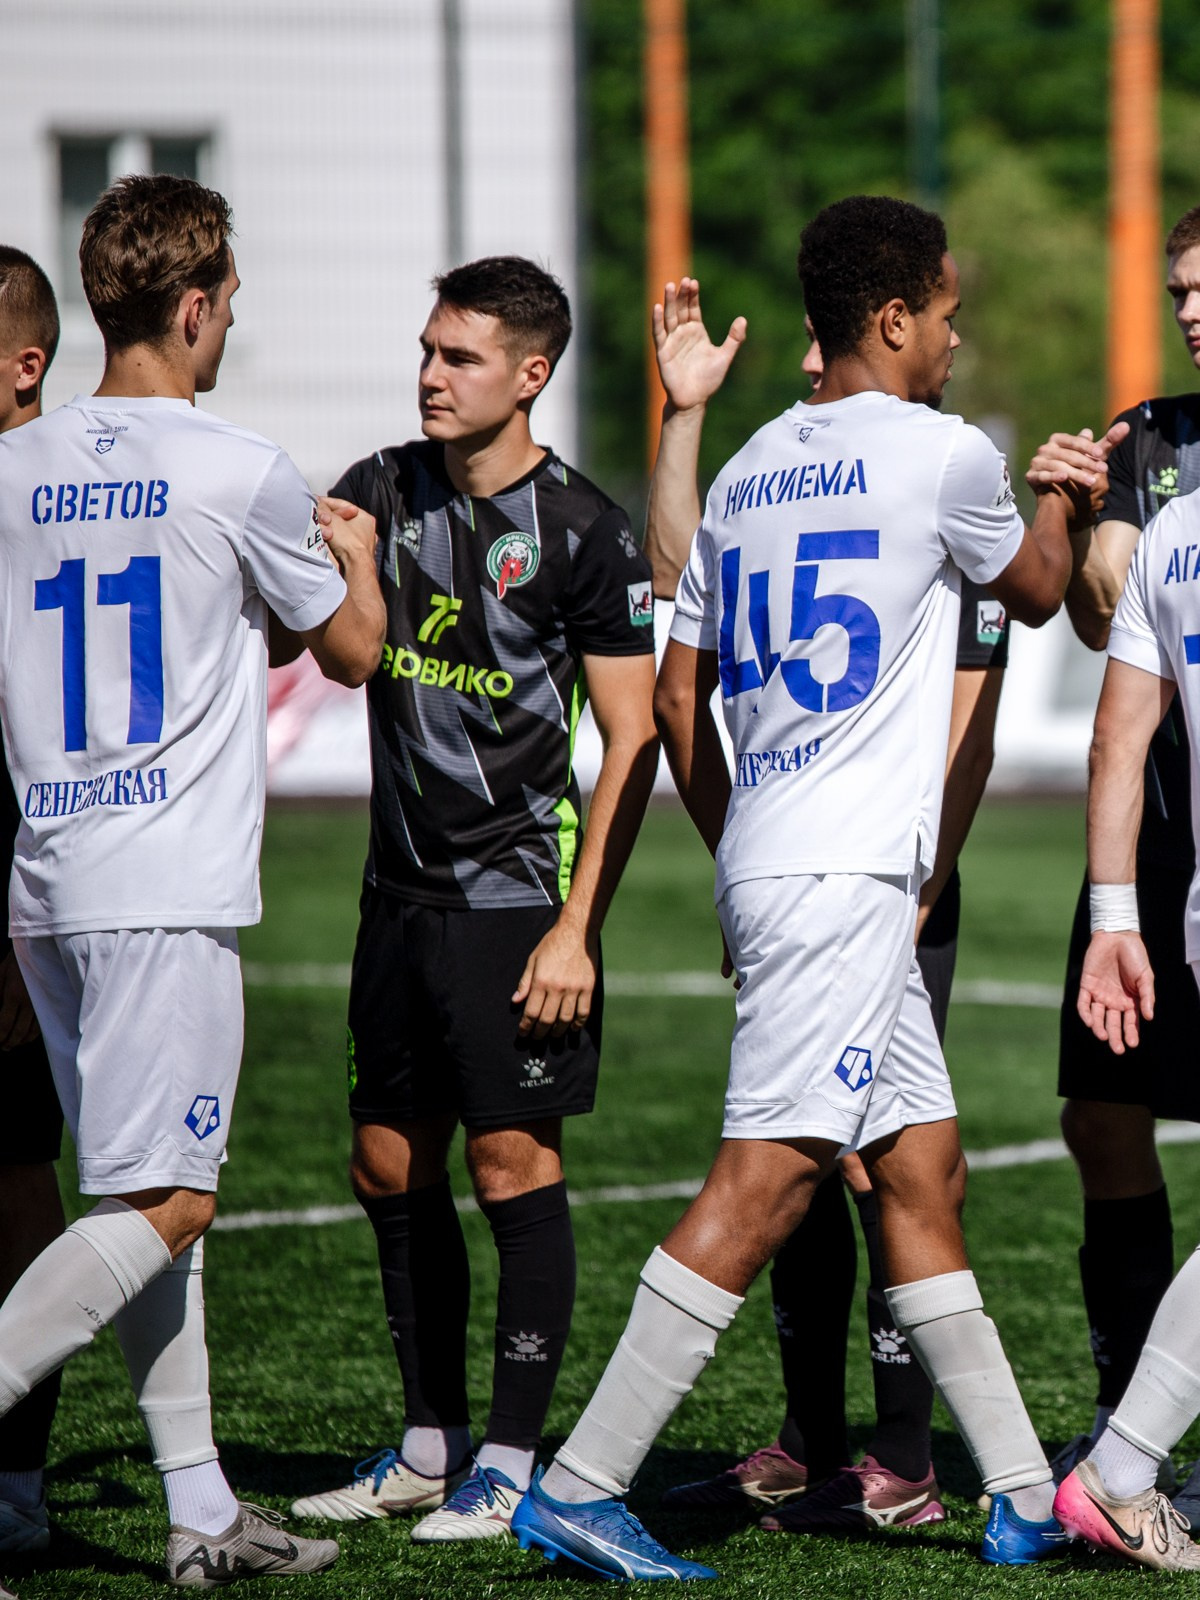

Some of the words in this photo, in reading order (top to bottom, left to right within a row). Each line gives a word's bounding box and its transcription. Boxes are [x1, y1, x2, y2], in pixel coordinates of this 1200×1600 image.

[32, 479, 169, 525] СВЕТОВ
[723, 458, 868, 519] НИКИЕМА
[391, 535, 421, 552] KELM
[719, 529, 881, 713] 45
[34, 556, 163, 752] 11
[382, 643, 514, 698] ервико
[519, 1076, 555, 1088] KELME
[504, 1351, 548, 1362] KELME
